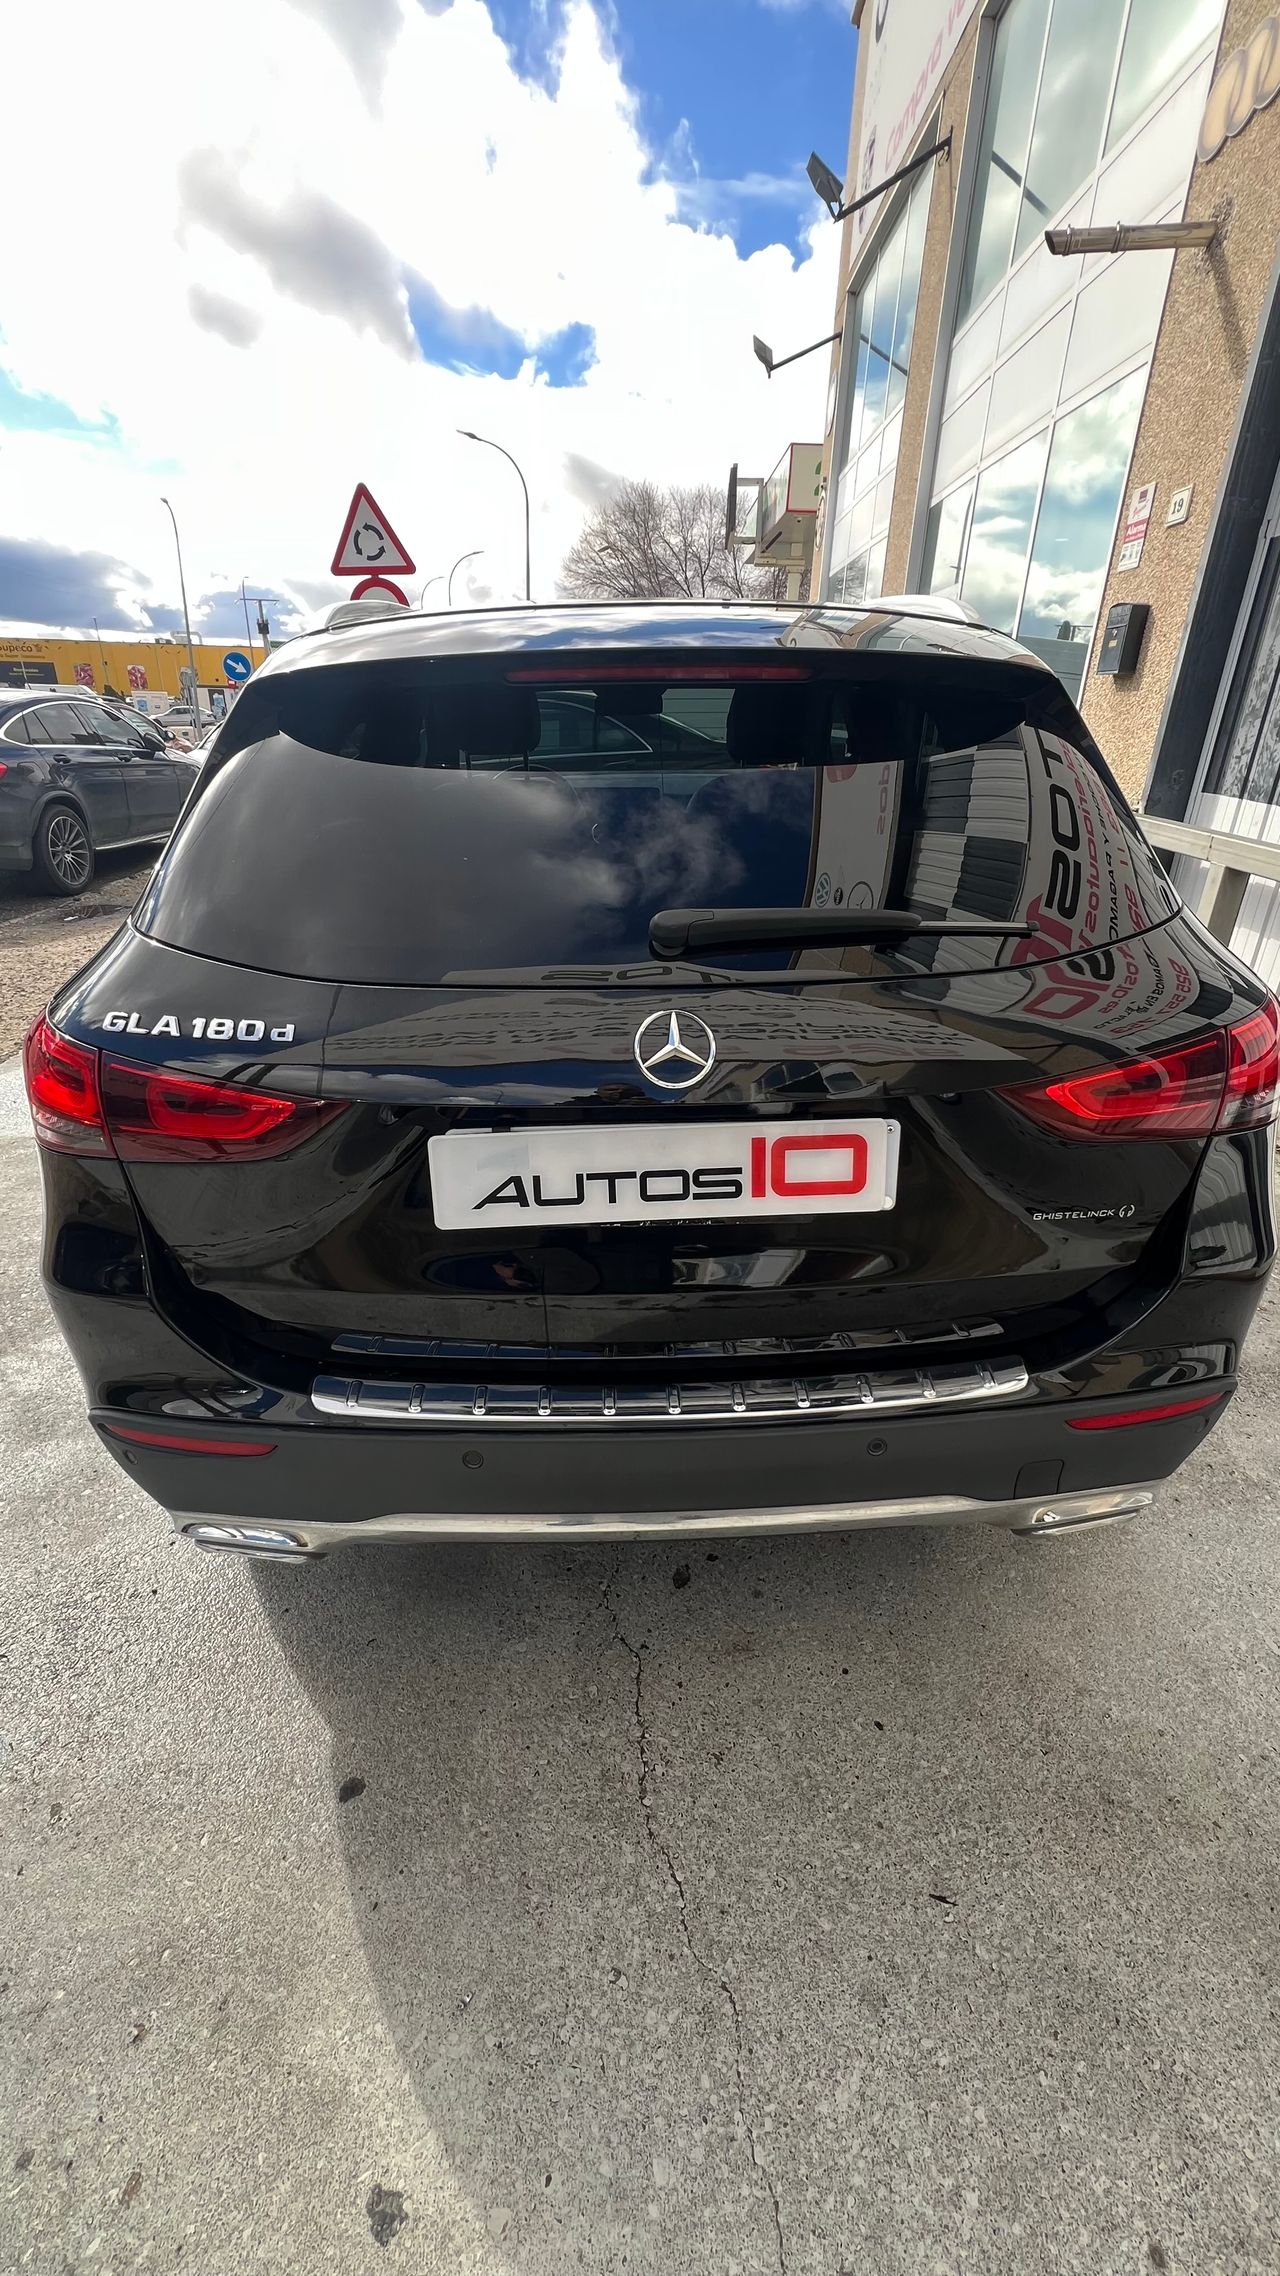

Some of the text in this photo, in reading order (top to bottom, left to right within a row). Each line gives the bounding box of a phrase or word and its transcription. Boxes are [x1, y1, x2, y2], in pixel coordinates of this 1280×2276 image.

[1171, 498, 1184, 515] 19
[102, 1011, 296, 1042] GLA 180 d
[1033, 1208, 1115, 1220] GHISTELINCK
